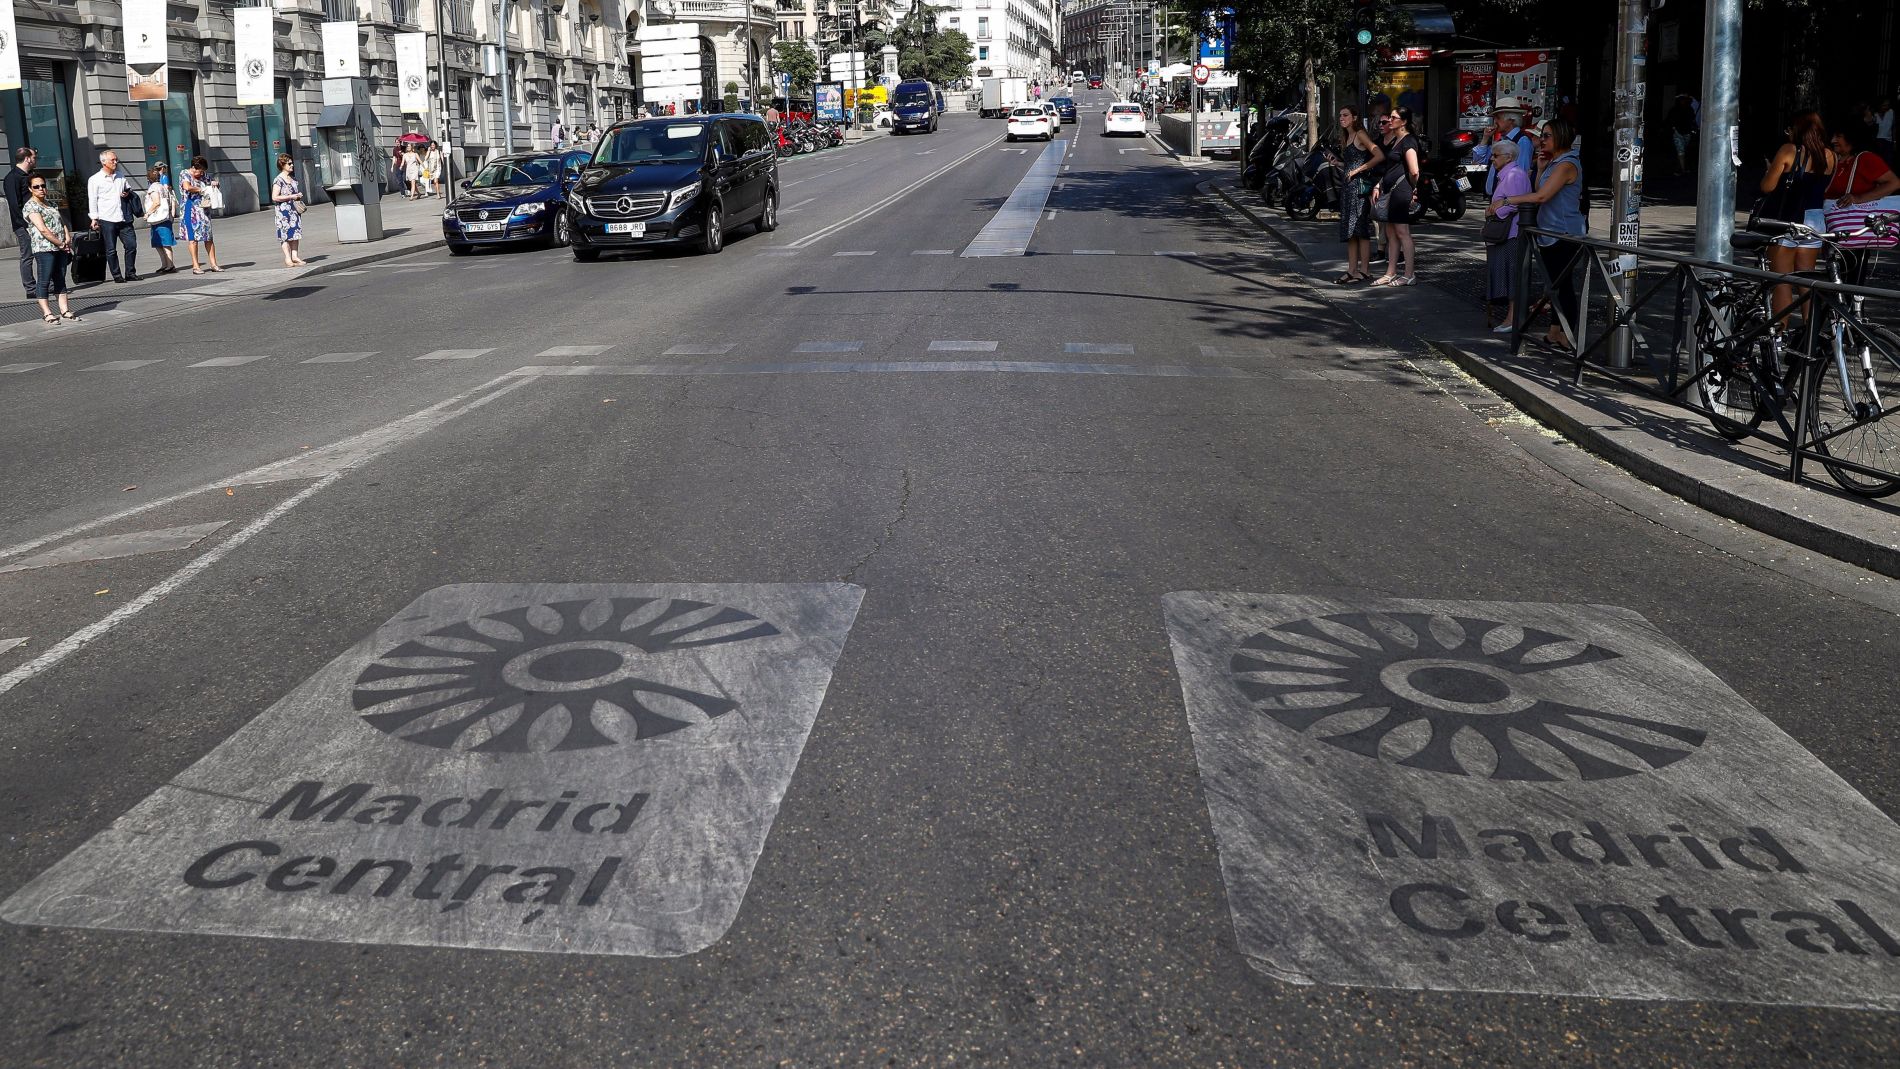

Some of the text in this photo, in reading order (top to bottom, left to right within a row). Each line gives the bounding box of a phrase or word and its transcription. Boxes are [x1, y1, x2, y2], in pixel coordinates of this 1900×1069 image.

[1463, 64, 1493, 73] MADRID
[609, 223, 628, 232] 8688
[1619, 224, 1637, 235] BNE
[258, 779, 651, 836] Madrid
[1365, 811, 1811, 875] Madrid
[182, 839, 623, 910] Central
[1388, 881, 1900, 957] Central
